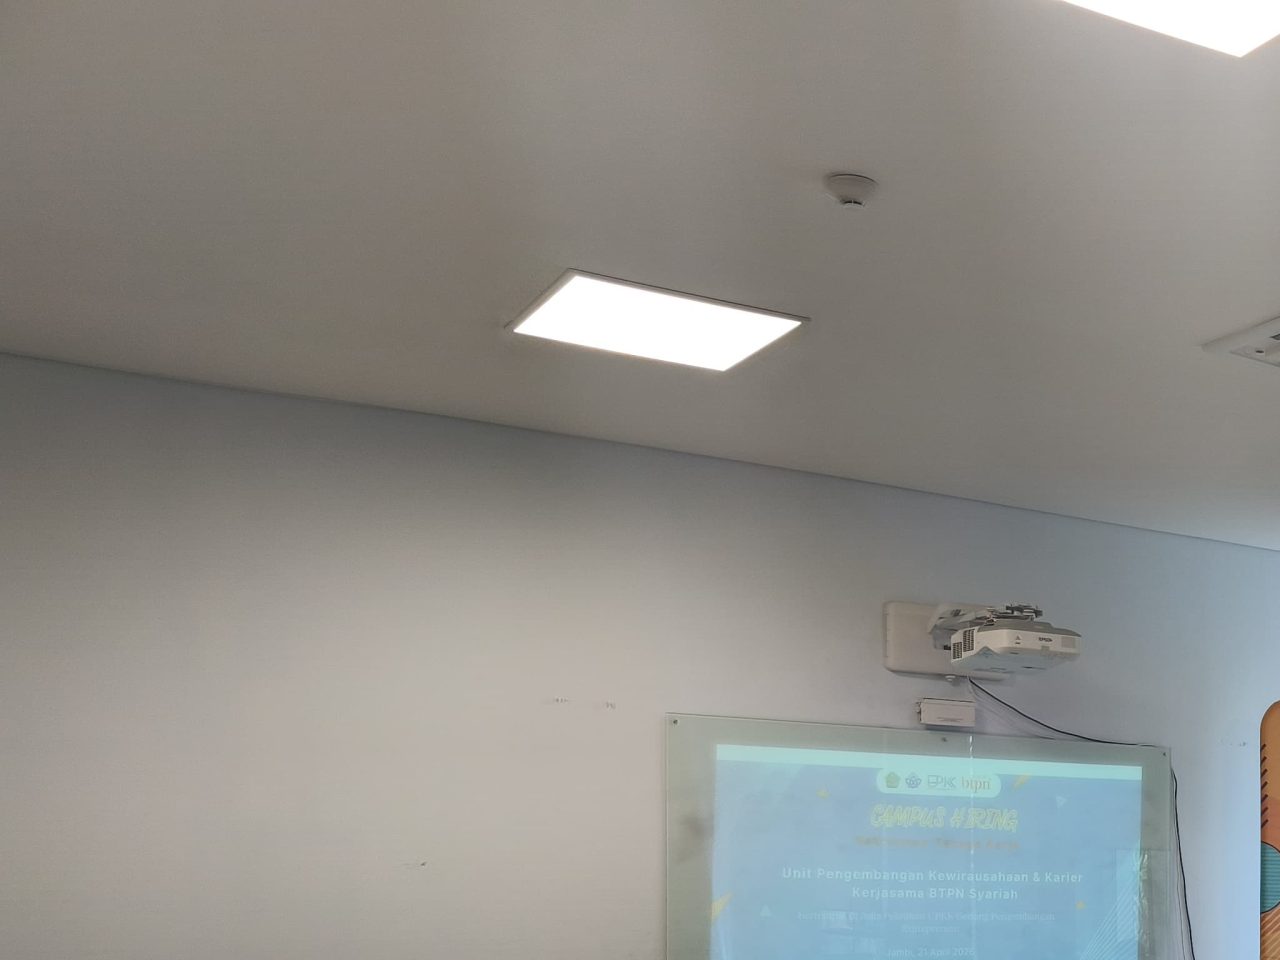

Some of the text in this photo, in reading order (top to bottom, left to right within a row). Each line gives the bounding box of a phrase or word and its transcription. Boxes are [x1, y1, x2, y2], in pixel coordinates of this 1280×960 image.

[870, 804, 1019, 832] CAMPUS HIRING
[782, 867, 1083, 883] Unit Pengembangan Kewirausahaan & Karier
[852, 887, 1018, 900] Kerjasama BTPN Syariah
